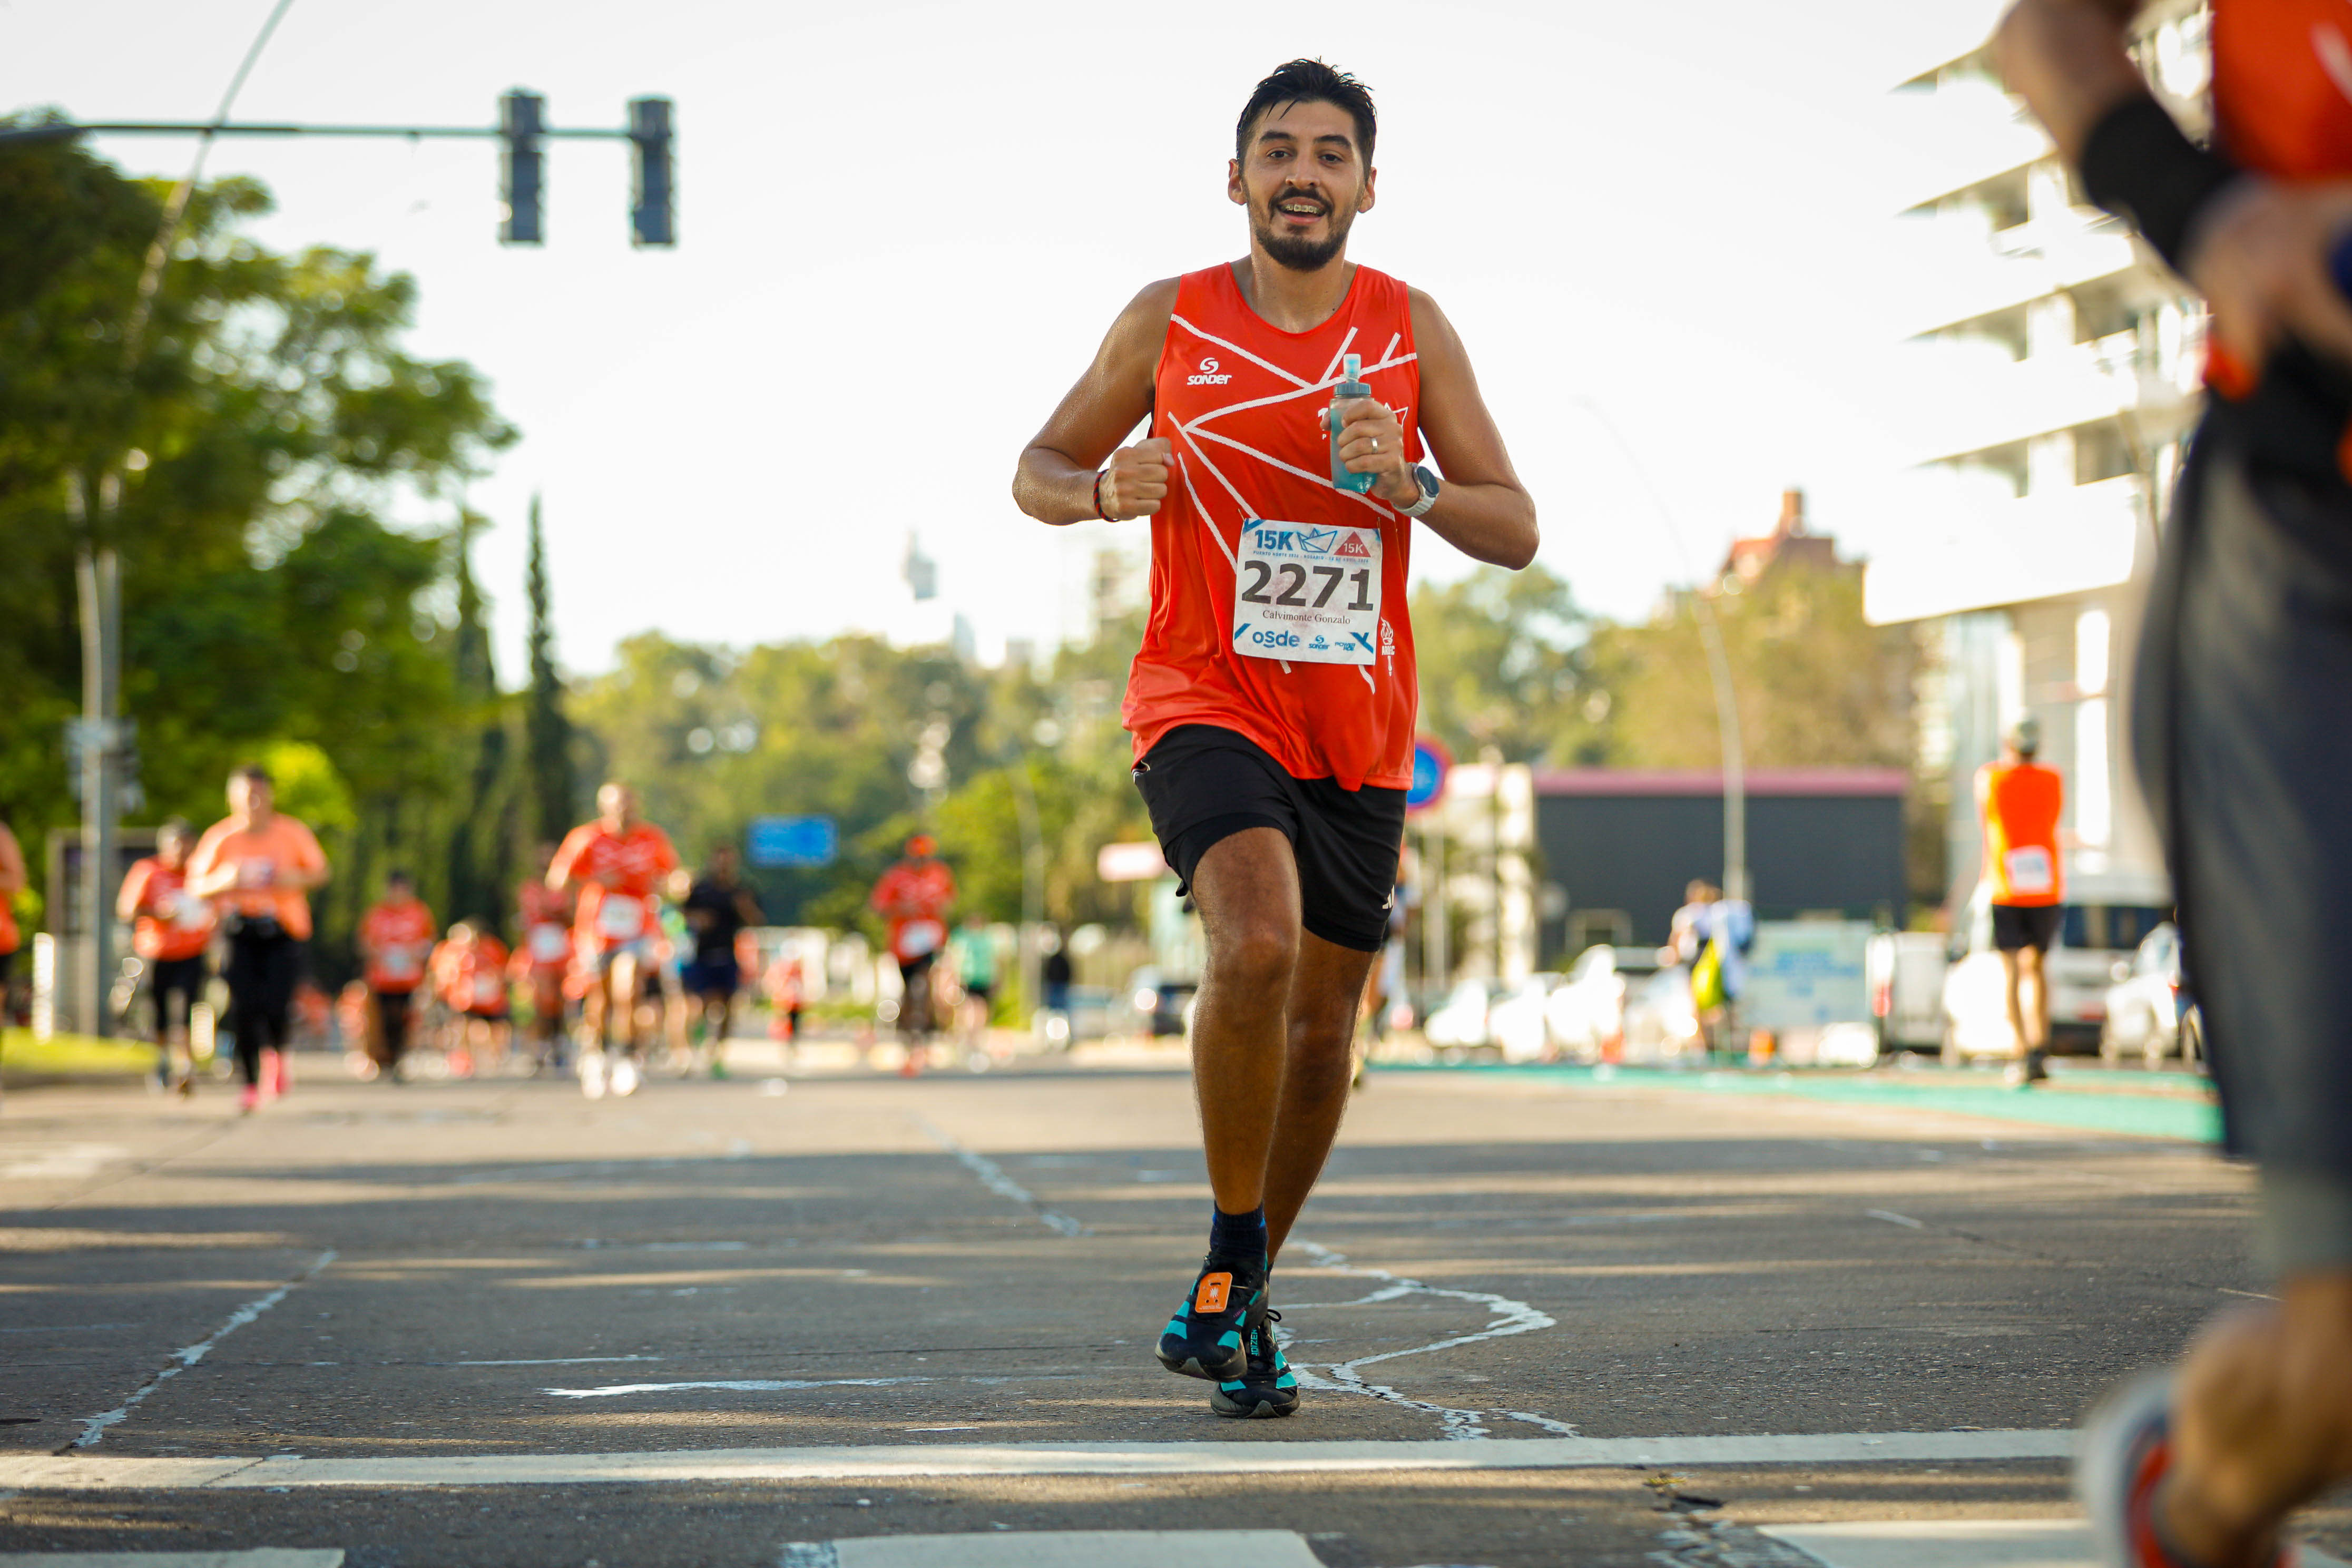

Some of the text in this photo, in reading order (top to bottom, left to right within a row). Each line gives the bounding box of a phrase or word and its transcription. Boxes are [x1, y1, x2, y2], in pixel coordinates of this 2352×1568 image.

[1255, 529, 1293, 551] 15K
[1343, 543, 1364, 554] 15K
[1241, 560, 1374, 611] 2271
[1262, 610, 1350, 624] Calvimonte Gonzalo
[1252, 630, 1300, 648] osde
